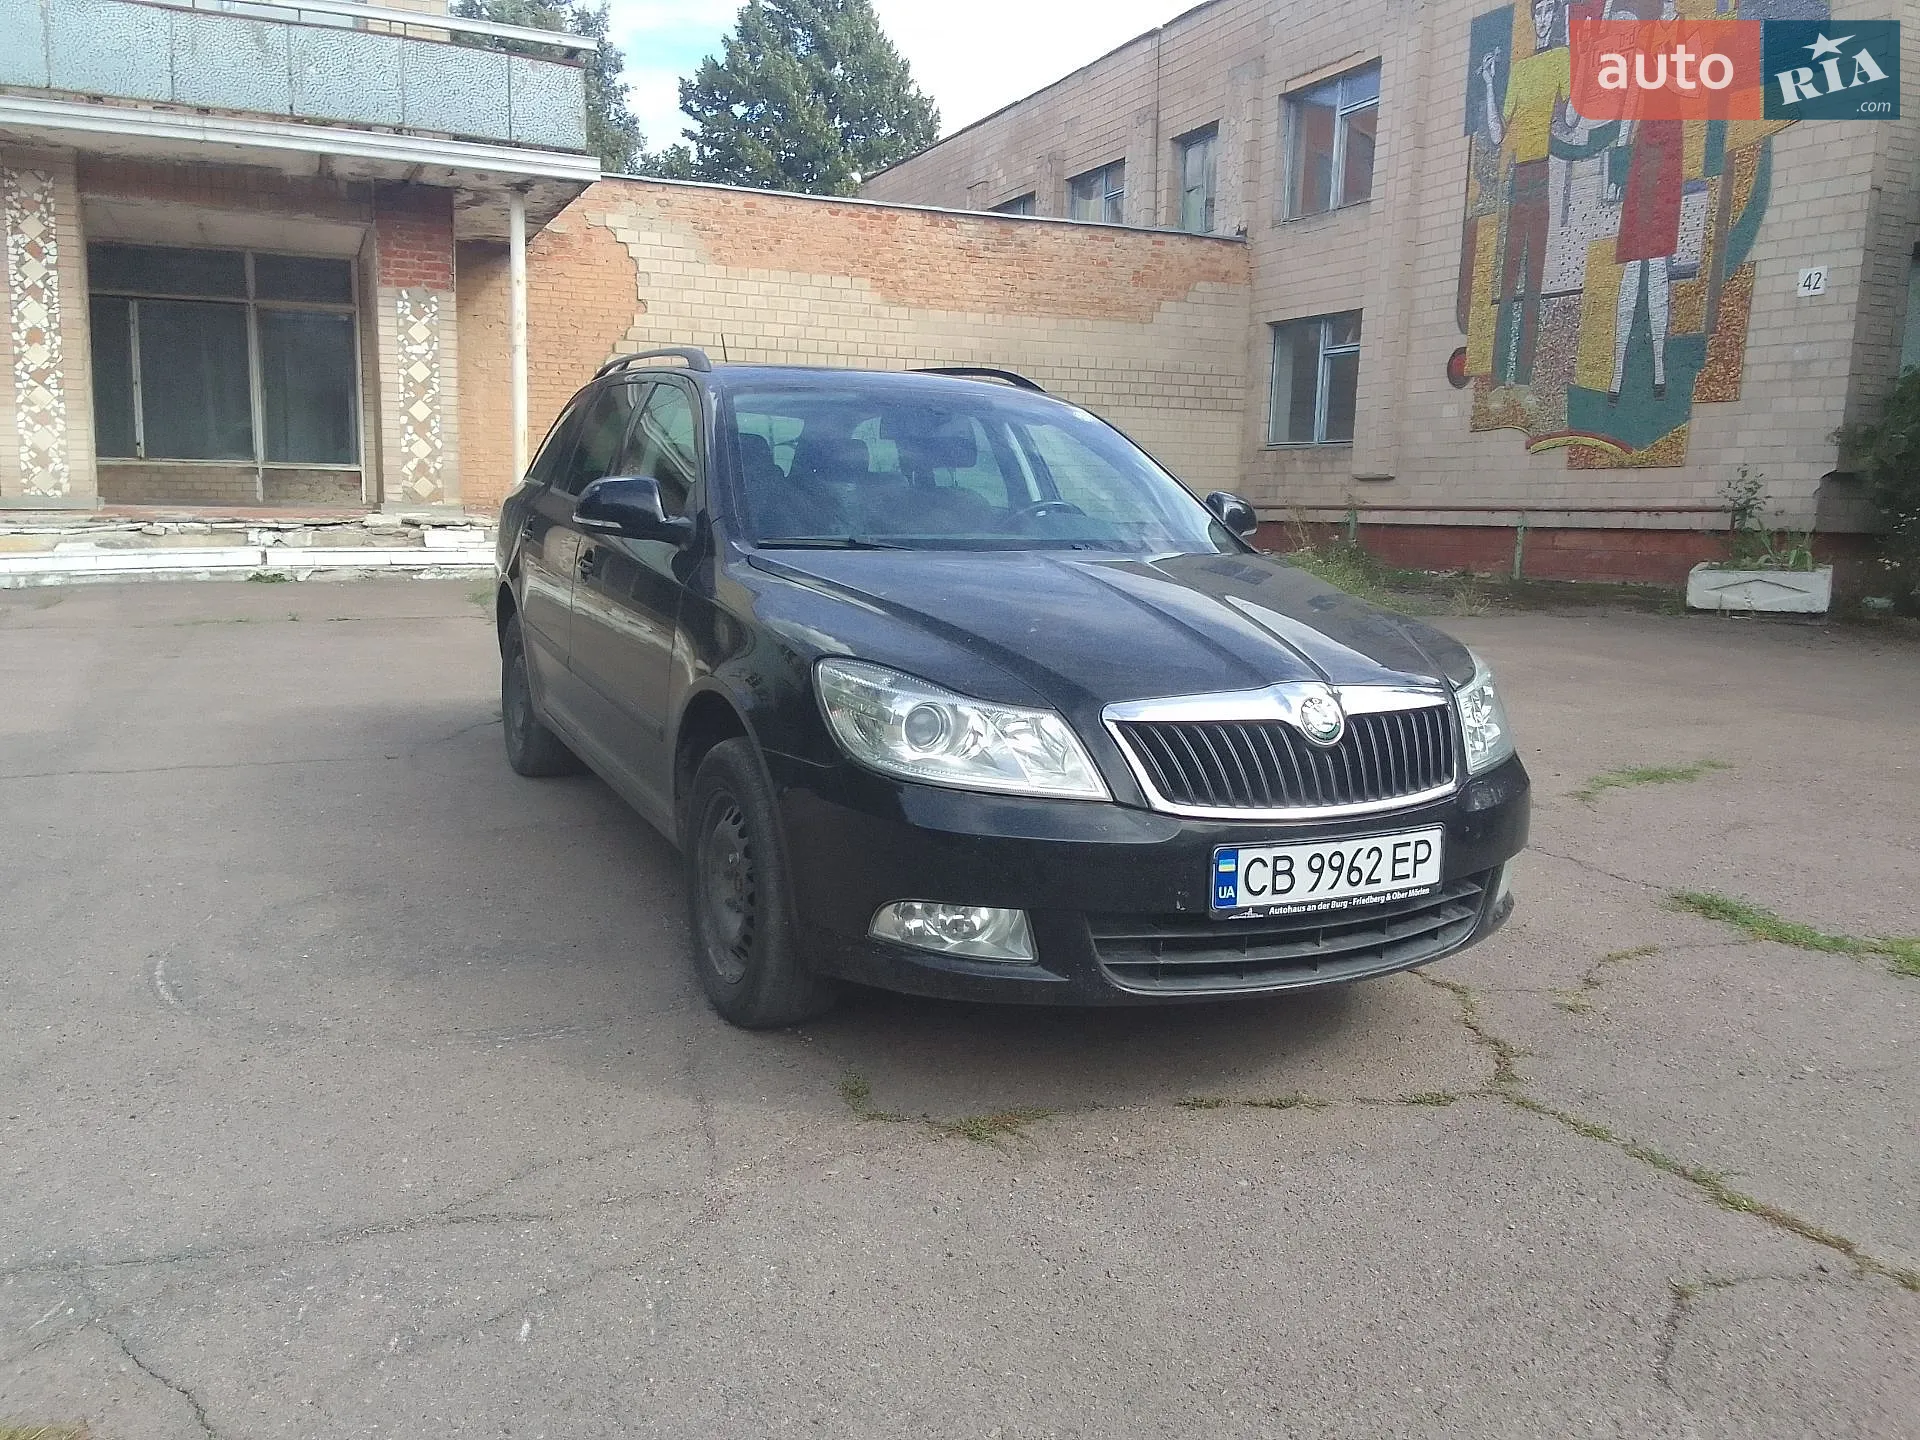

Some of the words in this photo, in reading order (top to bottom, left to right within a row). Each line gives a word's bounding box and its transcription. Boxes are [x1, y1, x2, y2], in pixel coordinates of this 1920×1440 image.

[1803, 271, 1822, 290] 42
[1244, 855, 1296, 897] CB
[1307, 846, 1383, 893] 9962
[1391, 839, 1432, 881] EP
[1218, 885, 1235, 899] UA
[1269, 904, 1306, 915] Autohaus
[1307, 904, 1316, 912] an
[1317, 902, 1330, 910] der
[1331, 900, 1348, 909] Burg
[1352, 895, 1385, 906] Friedberg
[1386, 893, 1392, 901] &
[1392, 891, 1408, 900] Ober
